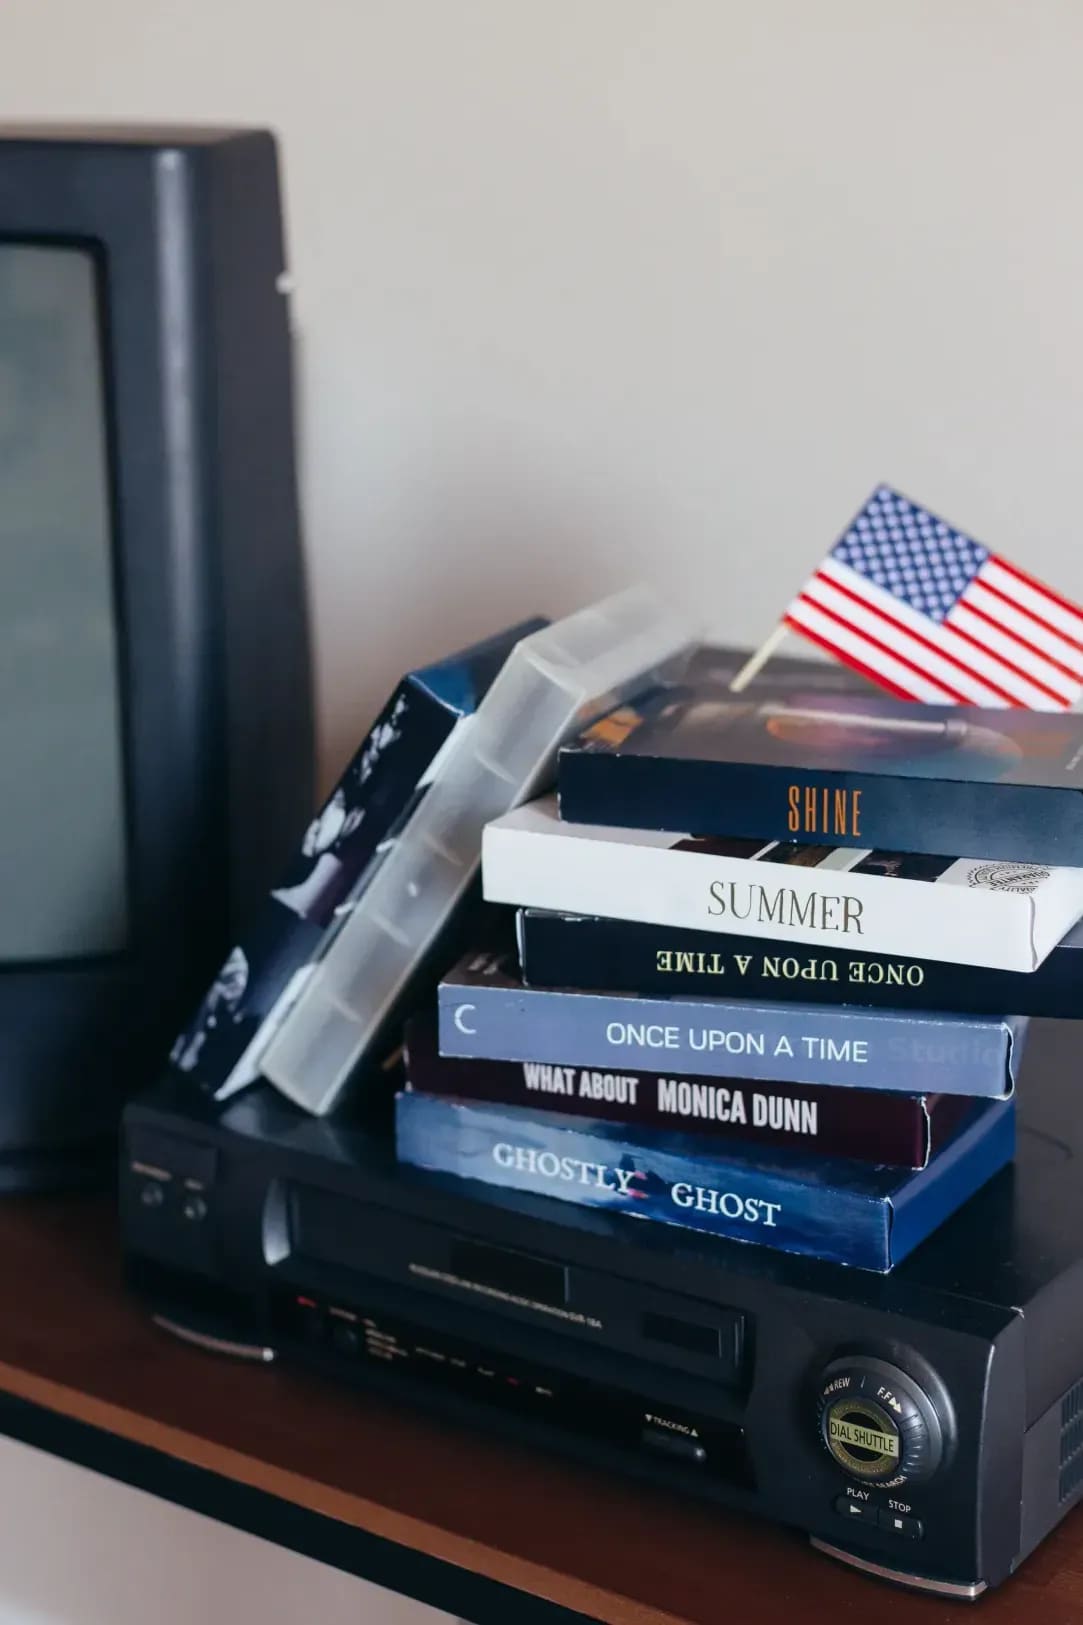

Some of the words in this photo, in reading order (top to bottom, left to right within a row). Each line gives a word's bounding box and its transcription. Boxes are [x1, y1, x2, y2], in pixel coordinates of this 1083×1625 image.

[787, 785, 862, 837] SHINE
[707, 880, 865, 935] SUMMER
[656, 950, 725, 975] TIME
[733, 954, 753, 976] A
[761, 956, 839, 982] UPON
[848, 961, 924, 987] ONCE
[605, 1022, 680, 1049] ONCE
[689, 1028, 765, 1055] UPON
[773, 1035, 794, 1058] A
[801, 1036, 869, 1063] TIME
[523, 1062, 576, 1096] WHAT
[579, 1070, 639, 1105] ABOUT
[657, 1079, 747, 1125] MONICA
[752, 1093, 819, 1136] DUNN
[492, 1142, 635, 1196] GHOSTLY
[671, 1183, 781, 1228] GHOST
[833, 1376, 852, 1390] REW
[829, 1421, 852, 1440] DIAL
[853, 1429, 895, 1453] SHUTTLE
[846, 1487, 870, 1501] PLAY
[888, 1499, 911, 1513] STOP
